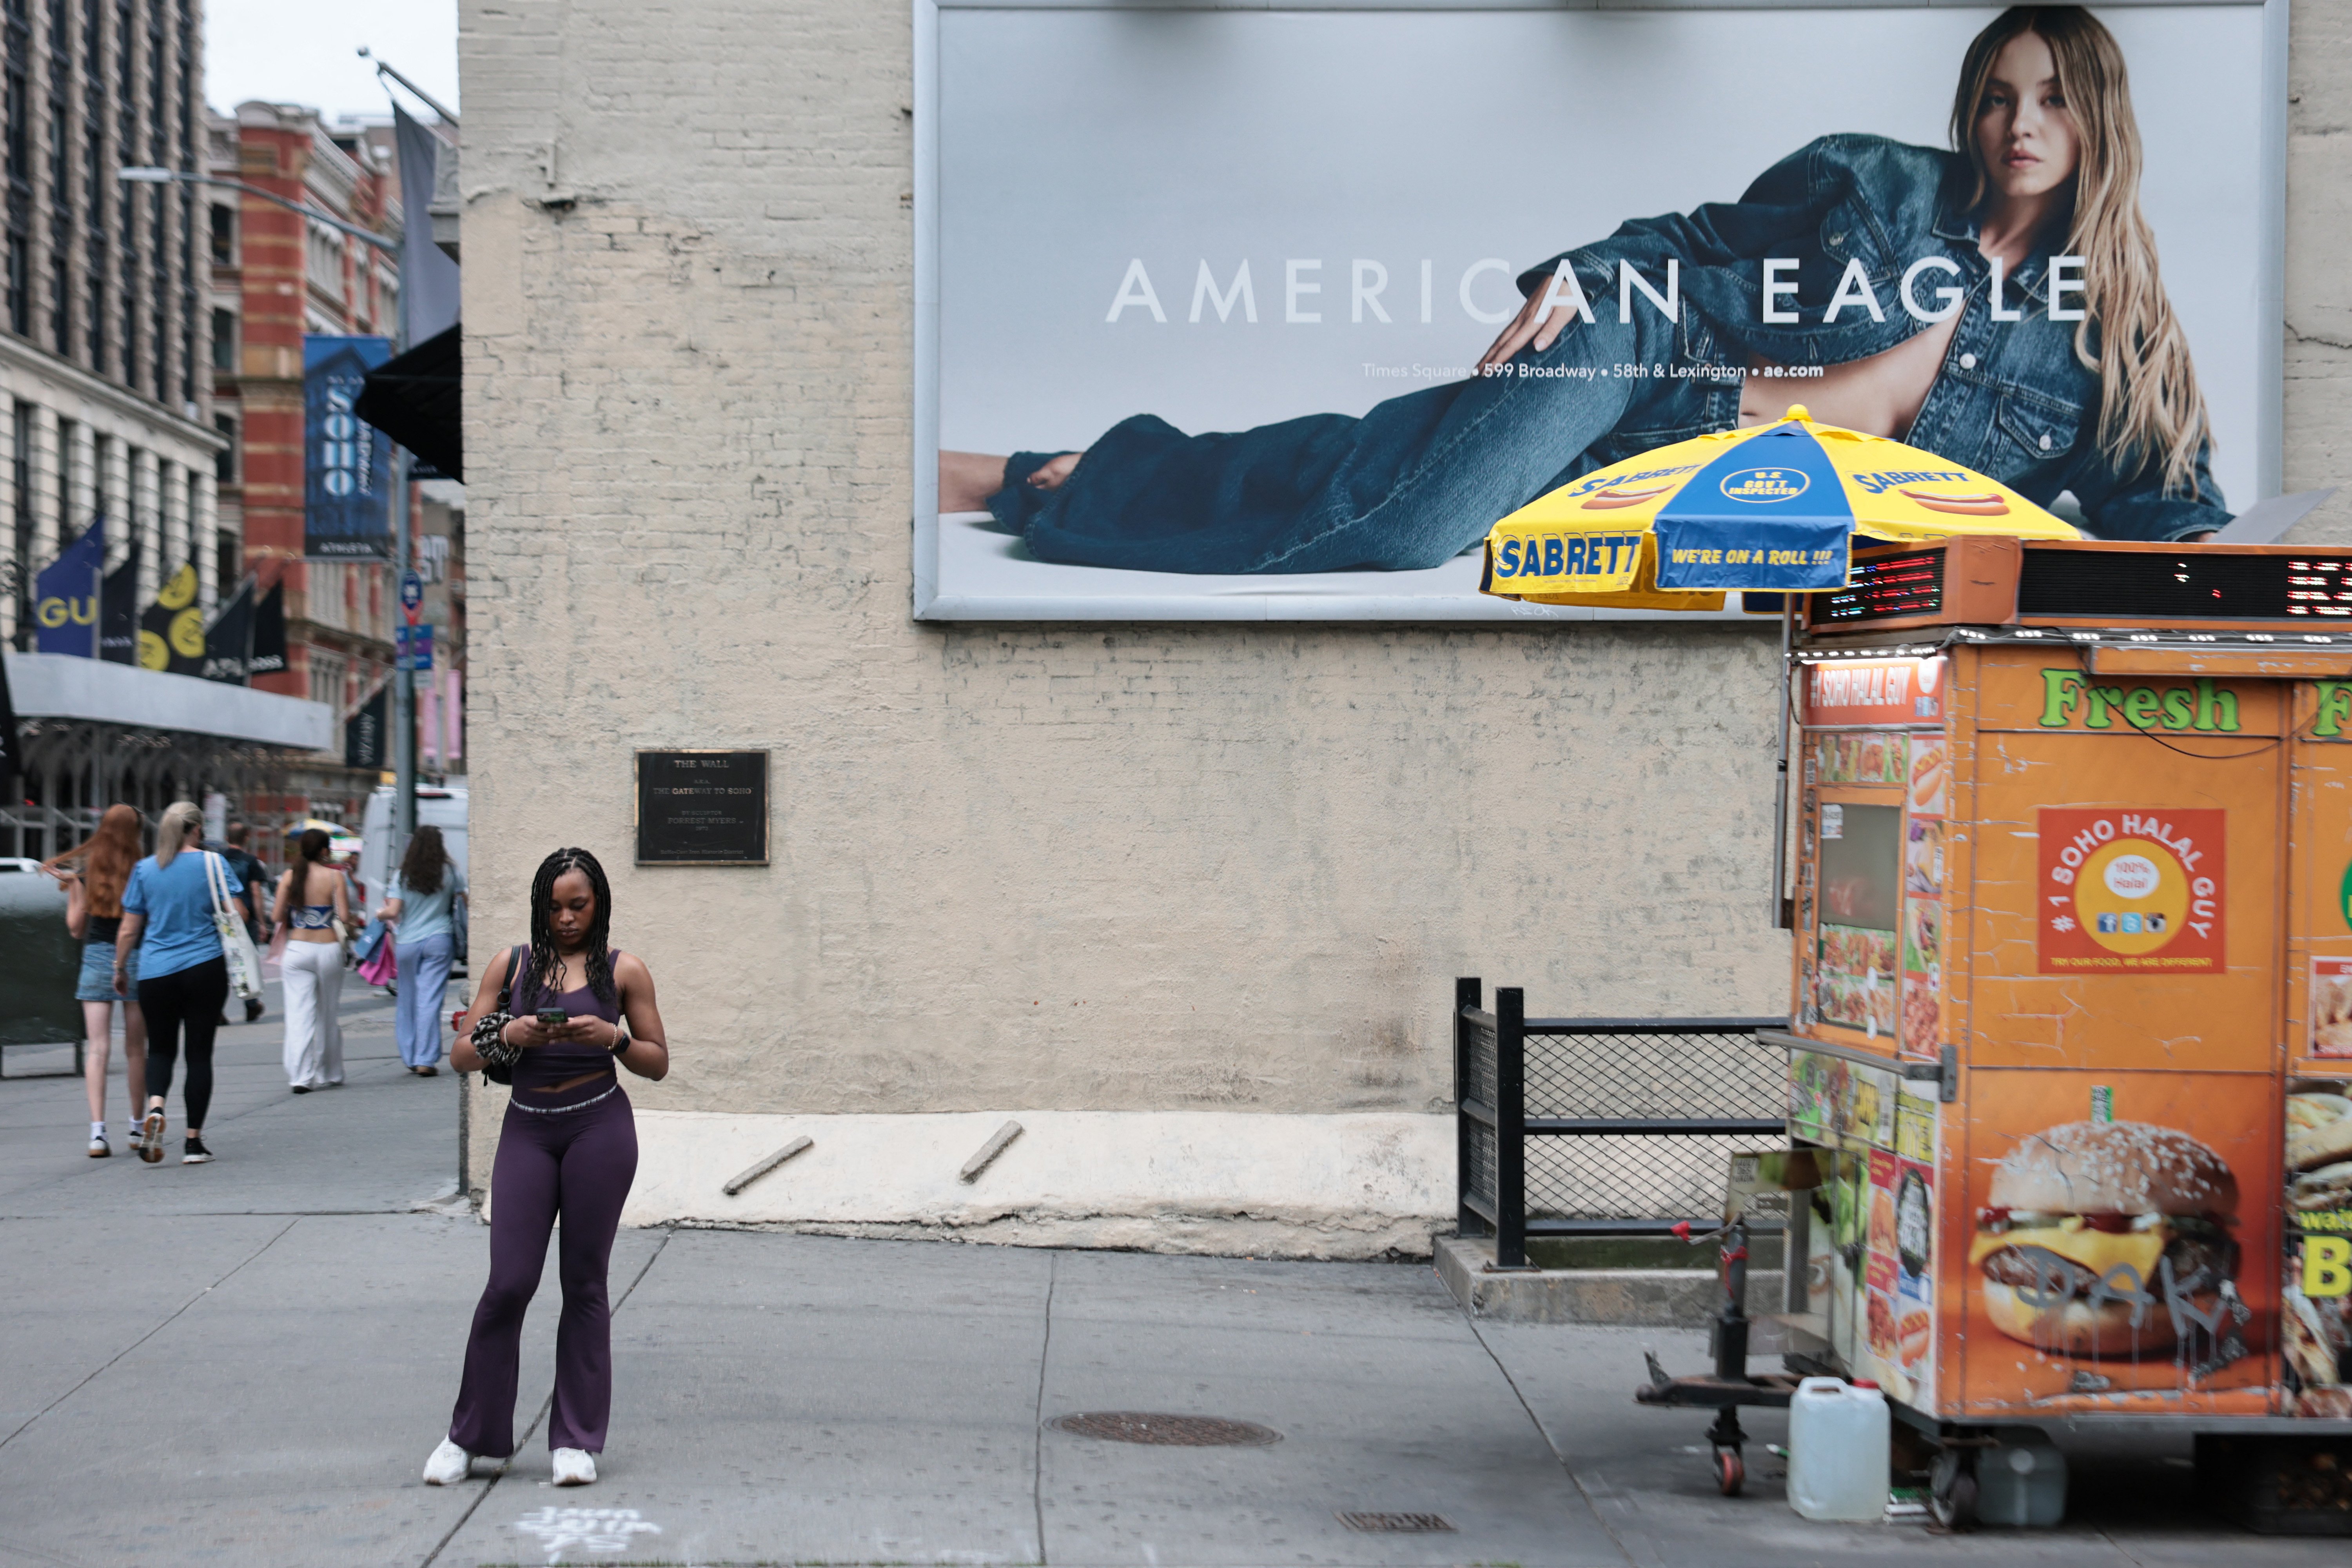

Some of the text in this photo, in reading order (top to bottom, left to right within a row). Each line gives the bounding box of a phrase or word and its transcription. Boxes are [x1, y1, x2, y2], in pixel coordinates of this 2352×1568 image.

[1105, 256, 2085, 323] AMERICAN EAGLE
[1361, 363, 1824, 381] Times Square 599 Broadway 58th & Lexington ae.com
[1568, 462, 1704, 497] SABRETT
[1744, 480, 1788, 488] GOV'T
[1845, 469, 1972, 494] SABRETT
[1494, 530, 1643, 578] SABRETT
[1671, 550, 1833, 565] WE'RE ON A ROLL !!!
[39, 596, 97, 628] GU
[1822, 669, 1851, 707] SOHO
[2039, 668, 2240, 732] Fresh
[674, 760, 730, 768] THE WALL
[2051, 819, 2115, 886] SOHO
[2122, 813, 2203, 873] HALAL
[2188, 877, 2216, 939] GUY
